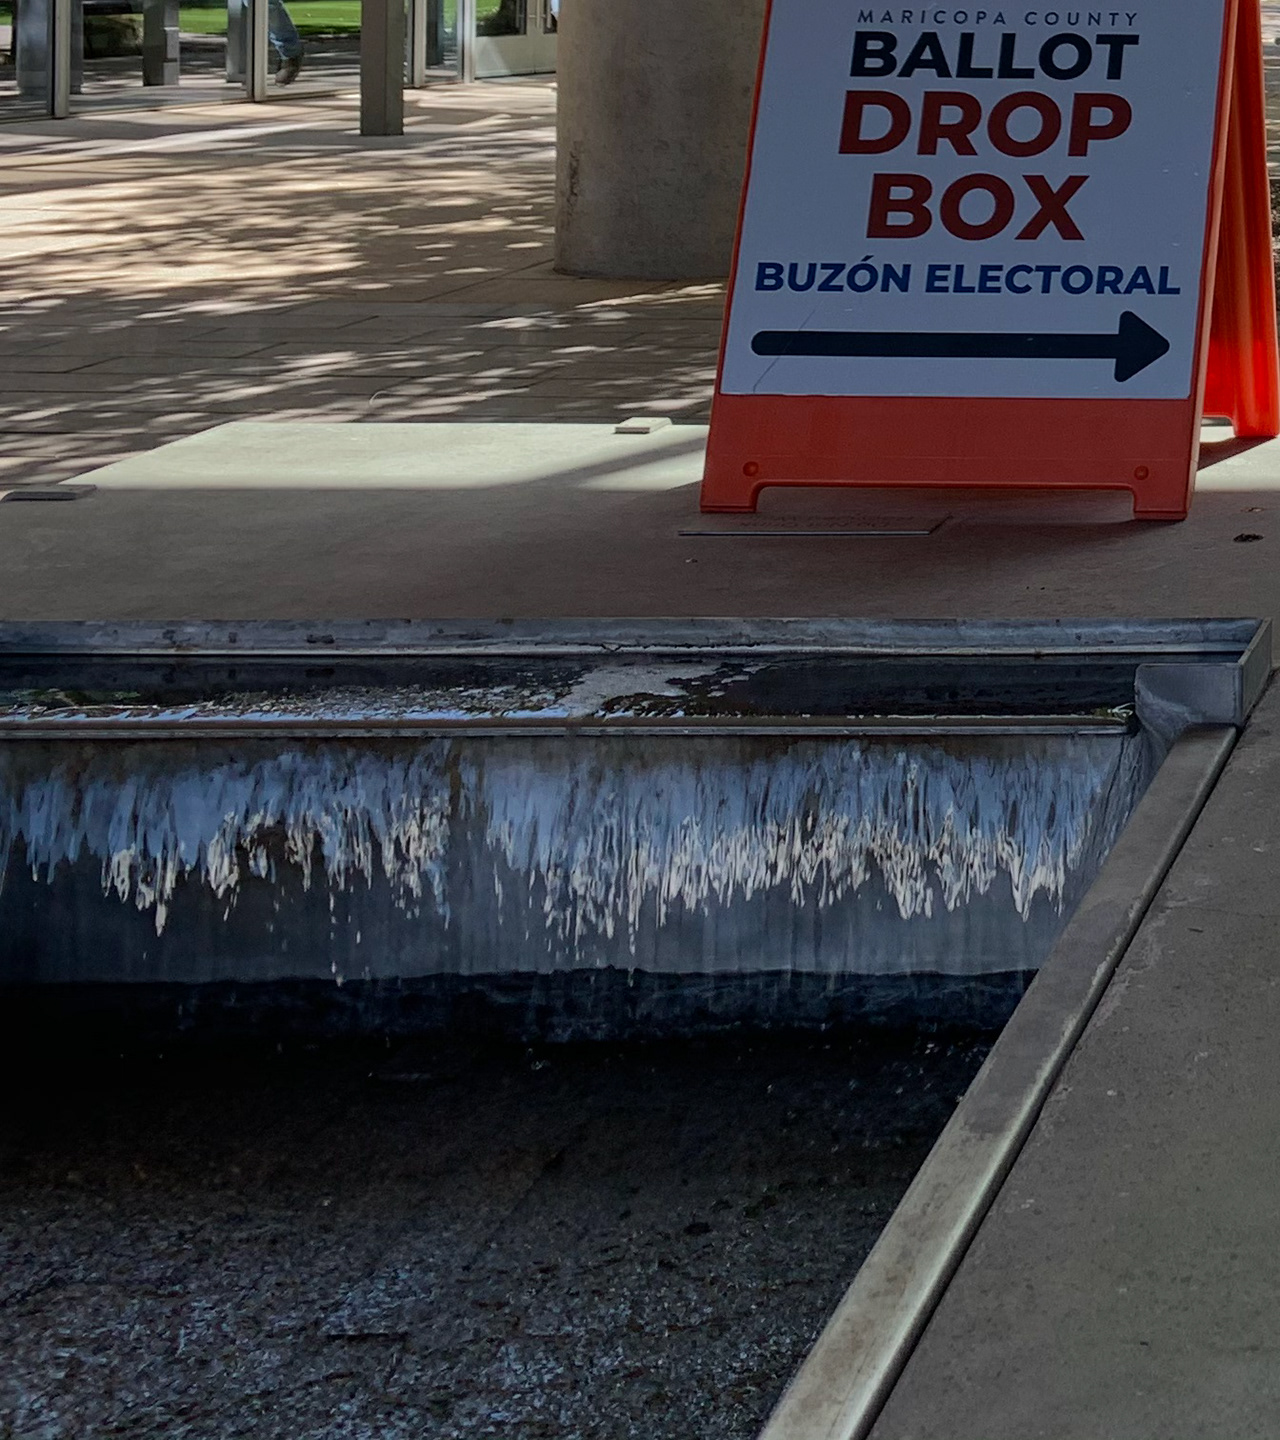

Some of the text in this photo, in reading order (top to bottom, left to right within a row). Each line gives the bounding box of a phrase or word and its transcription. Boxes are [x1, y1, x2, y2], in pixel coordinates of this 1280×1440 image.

[857, 9, 1138, 27] MARICOPA COUNTY
[849, 30, 1140, 81] BALLOT
[837, 89, 1133, 157] DROP
[865, 172, 1091, 241] BOX
[754, 255, 1181, 296] BUZÓN ELECTORAL
